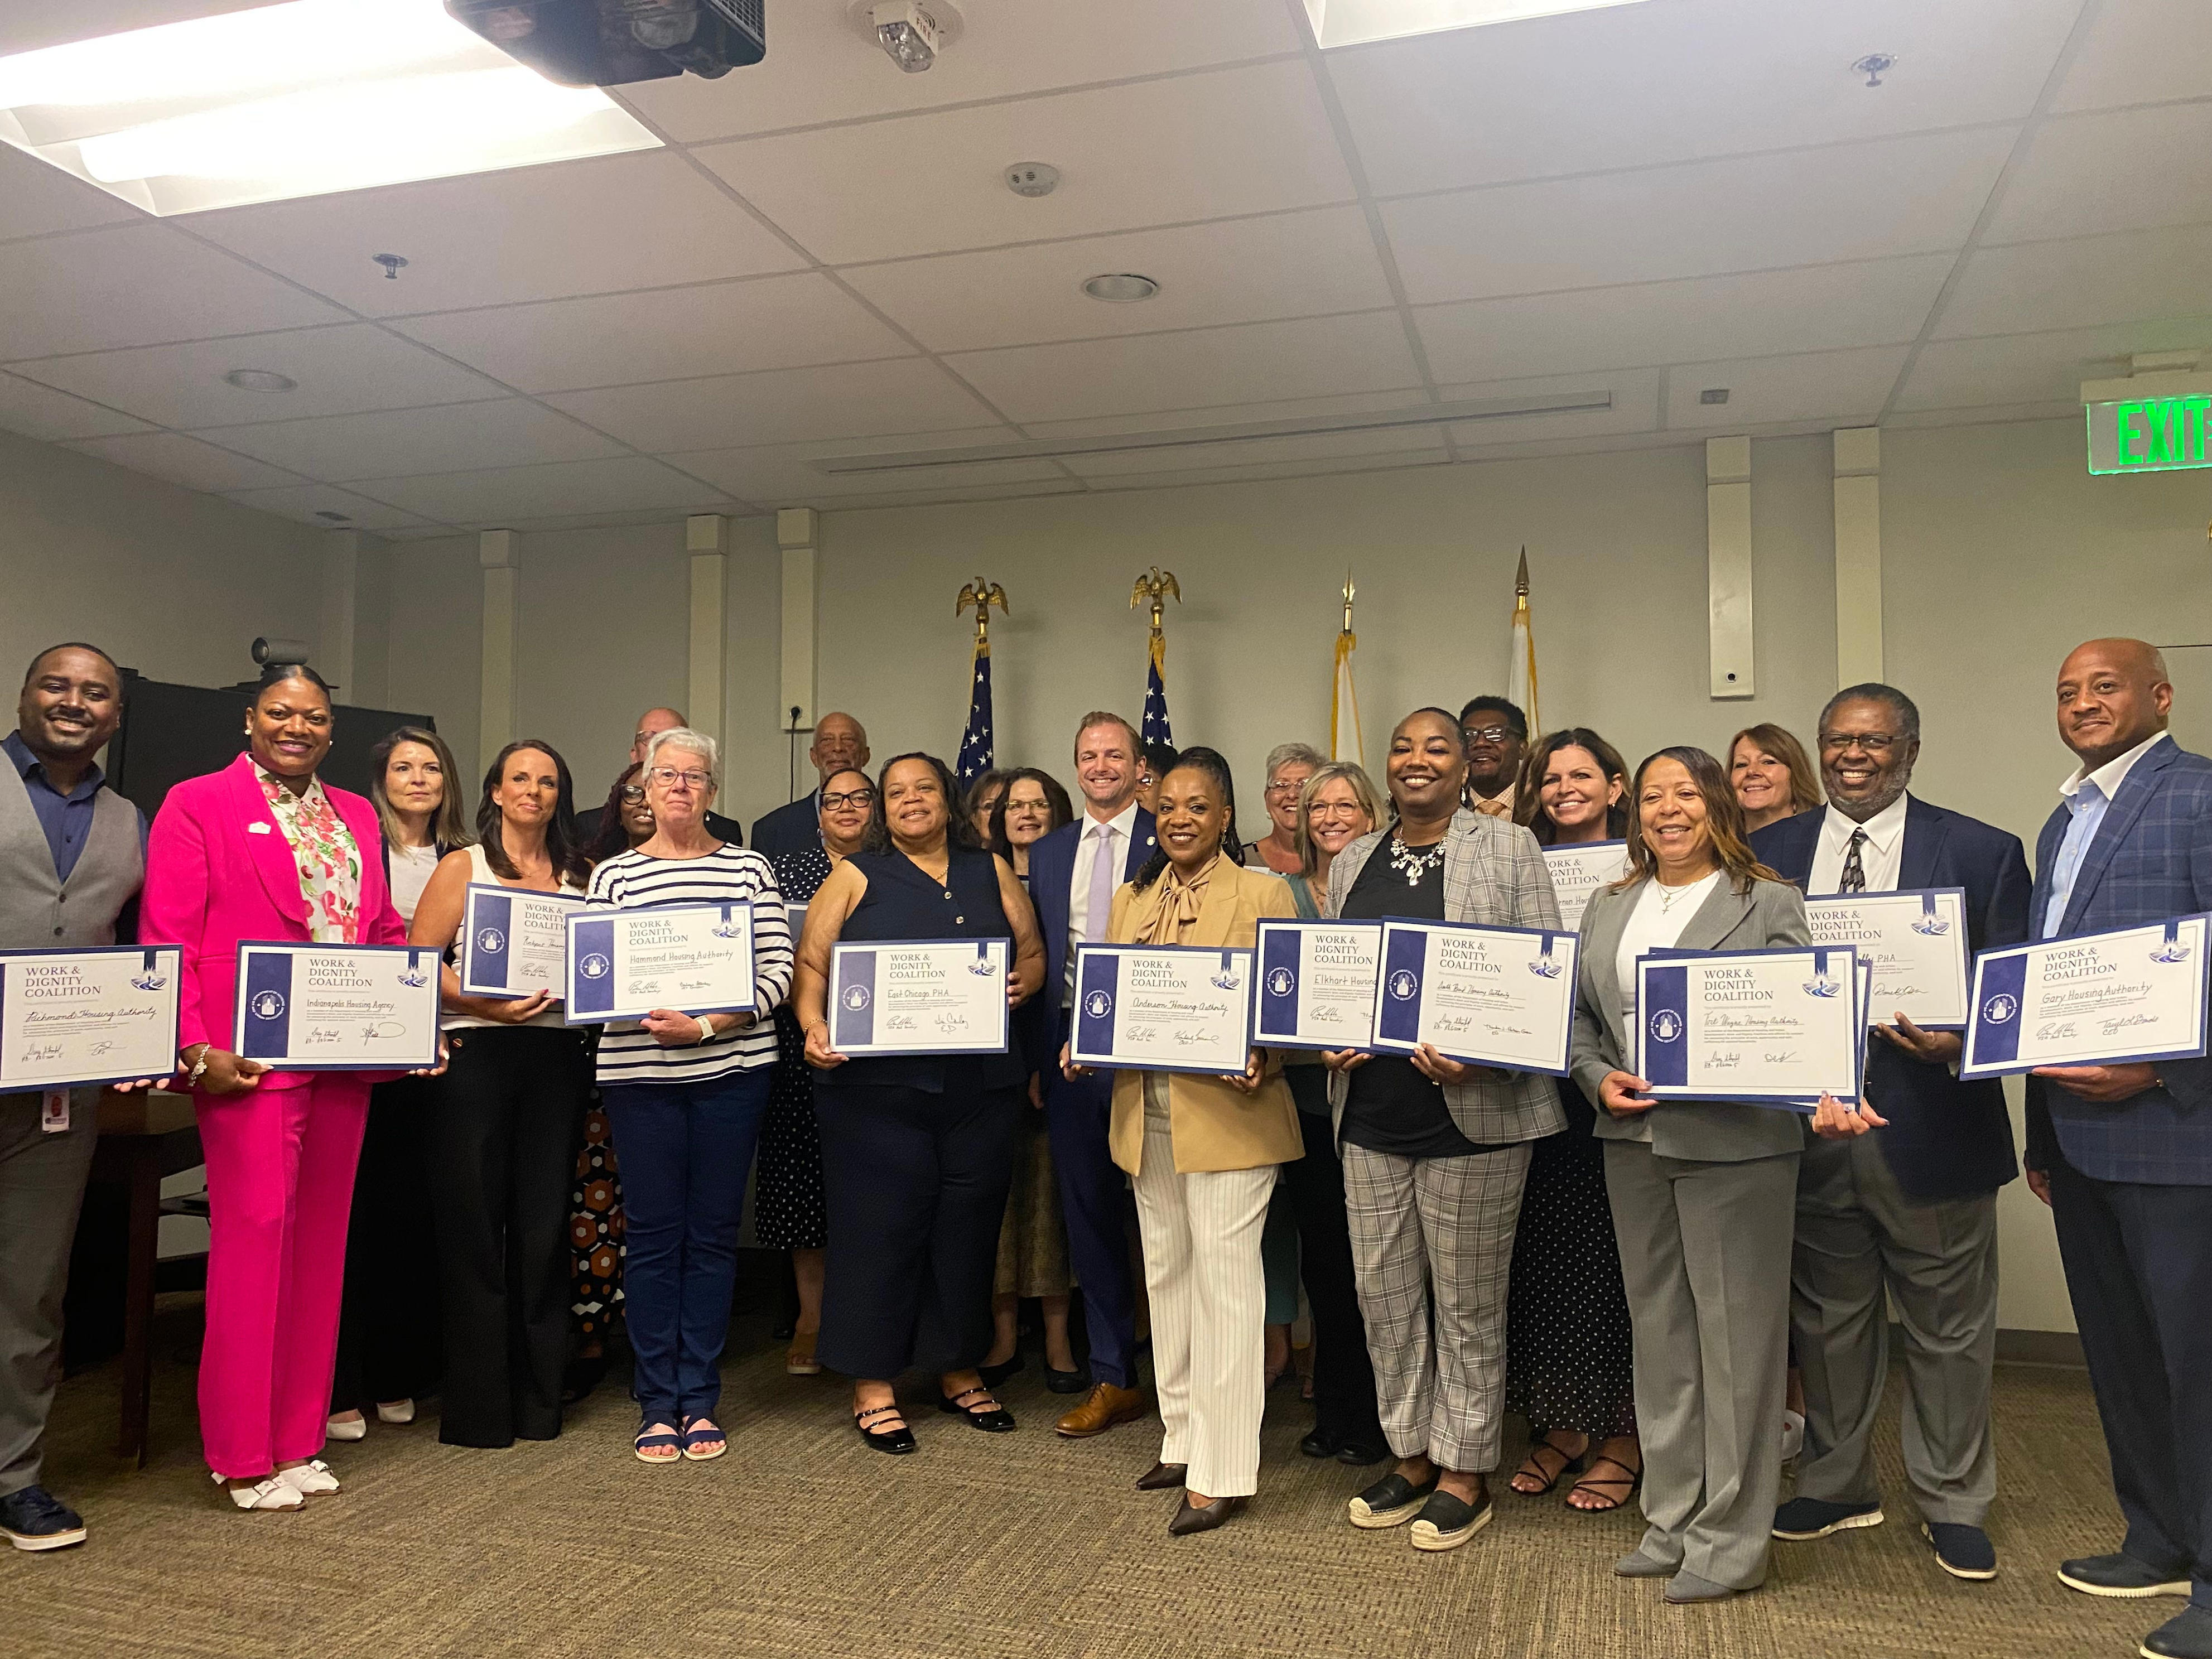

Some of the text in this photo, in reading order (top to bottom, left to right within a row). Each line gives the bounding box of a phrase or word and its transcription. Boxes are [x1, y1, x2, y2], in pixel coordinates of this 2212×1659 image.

[2118, 399, 2210, 465] EXIT
[1545, 860, 1571, 868] ORK
[1550, 867, 1584, 876] GNITY
[1555, 875, 1600, 886] ALITION
[525, 904, 555, 913] WORK
[525, 912, 565, 922] DIGNITY
[1809, 910, 1861, 920] WORK &
[524, 920, 566, 930] COALITI
[629, 920, 661, 929] WORK
[1811, 920, 1863, 931] DIGNITY
[629, 928, 674, 937] DIGNITY
[1811, 930, 1882, 941] COALITION
[629, 935, 688, 946] COALITION
[1315, 935, 1347, 944] WORK
[1442, 939, 1486, 951] WORK &
[630, 949, 734, 964] Hammond Housing Authority
[1314, 955, 1373, 964] COALITION
[1441, 949, 1487, 961] DIGNITY
[2045, 947, 2098, 962] WORK &
[310, 959, 344, 967] WORK
[1132, 960, 1163, 968] WORK
[1440, 959, 1502, 973] COALITION
[2045, 956, 2100, 972] DIGNITY
[26, 966, 81, 976] WORK &
[310, 968, 358, 977] DIGNITY
[1132, 970, 1174, 978] DIGNITY
[1704, 969, 1753, 978] WORK &
[2044, 963, 2118, 981] COALITION
[26, 977, 84, 987] DIGNITY
[309, 978, 372, 986] COALITION
[1131, 978, 1187, 988] COALITION
[1314, 975, 1348, 985] Elkhart
[1704, 980, 1756, 990] DIGNITY
[25, 986, 102, 997] COALITION
[888, 990, 903, 998] East
[905, 990, 929, 1000] Chicago
[1704, 991, 1774, 1001] COALITION
[2042, 993, 2066, 1004] Gary
[2068, 988, 2103, 1002] Housing
[2105, 981, 2152, 996] Authority
[307, 999, 394, 1011] Indianapolis Housing Agency
[1133, 997, 1168, 1008] Anderson
[1169, 1000, 1198, 1012] Housing
[1199, 1002, 1228, 1016] Authority
[26, 1006, 157, 1022] Richmond Housing Authority
